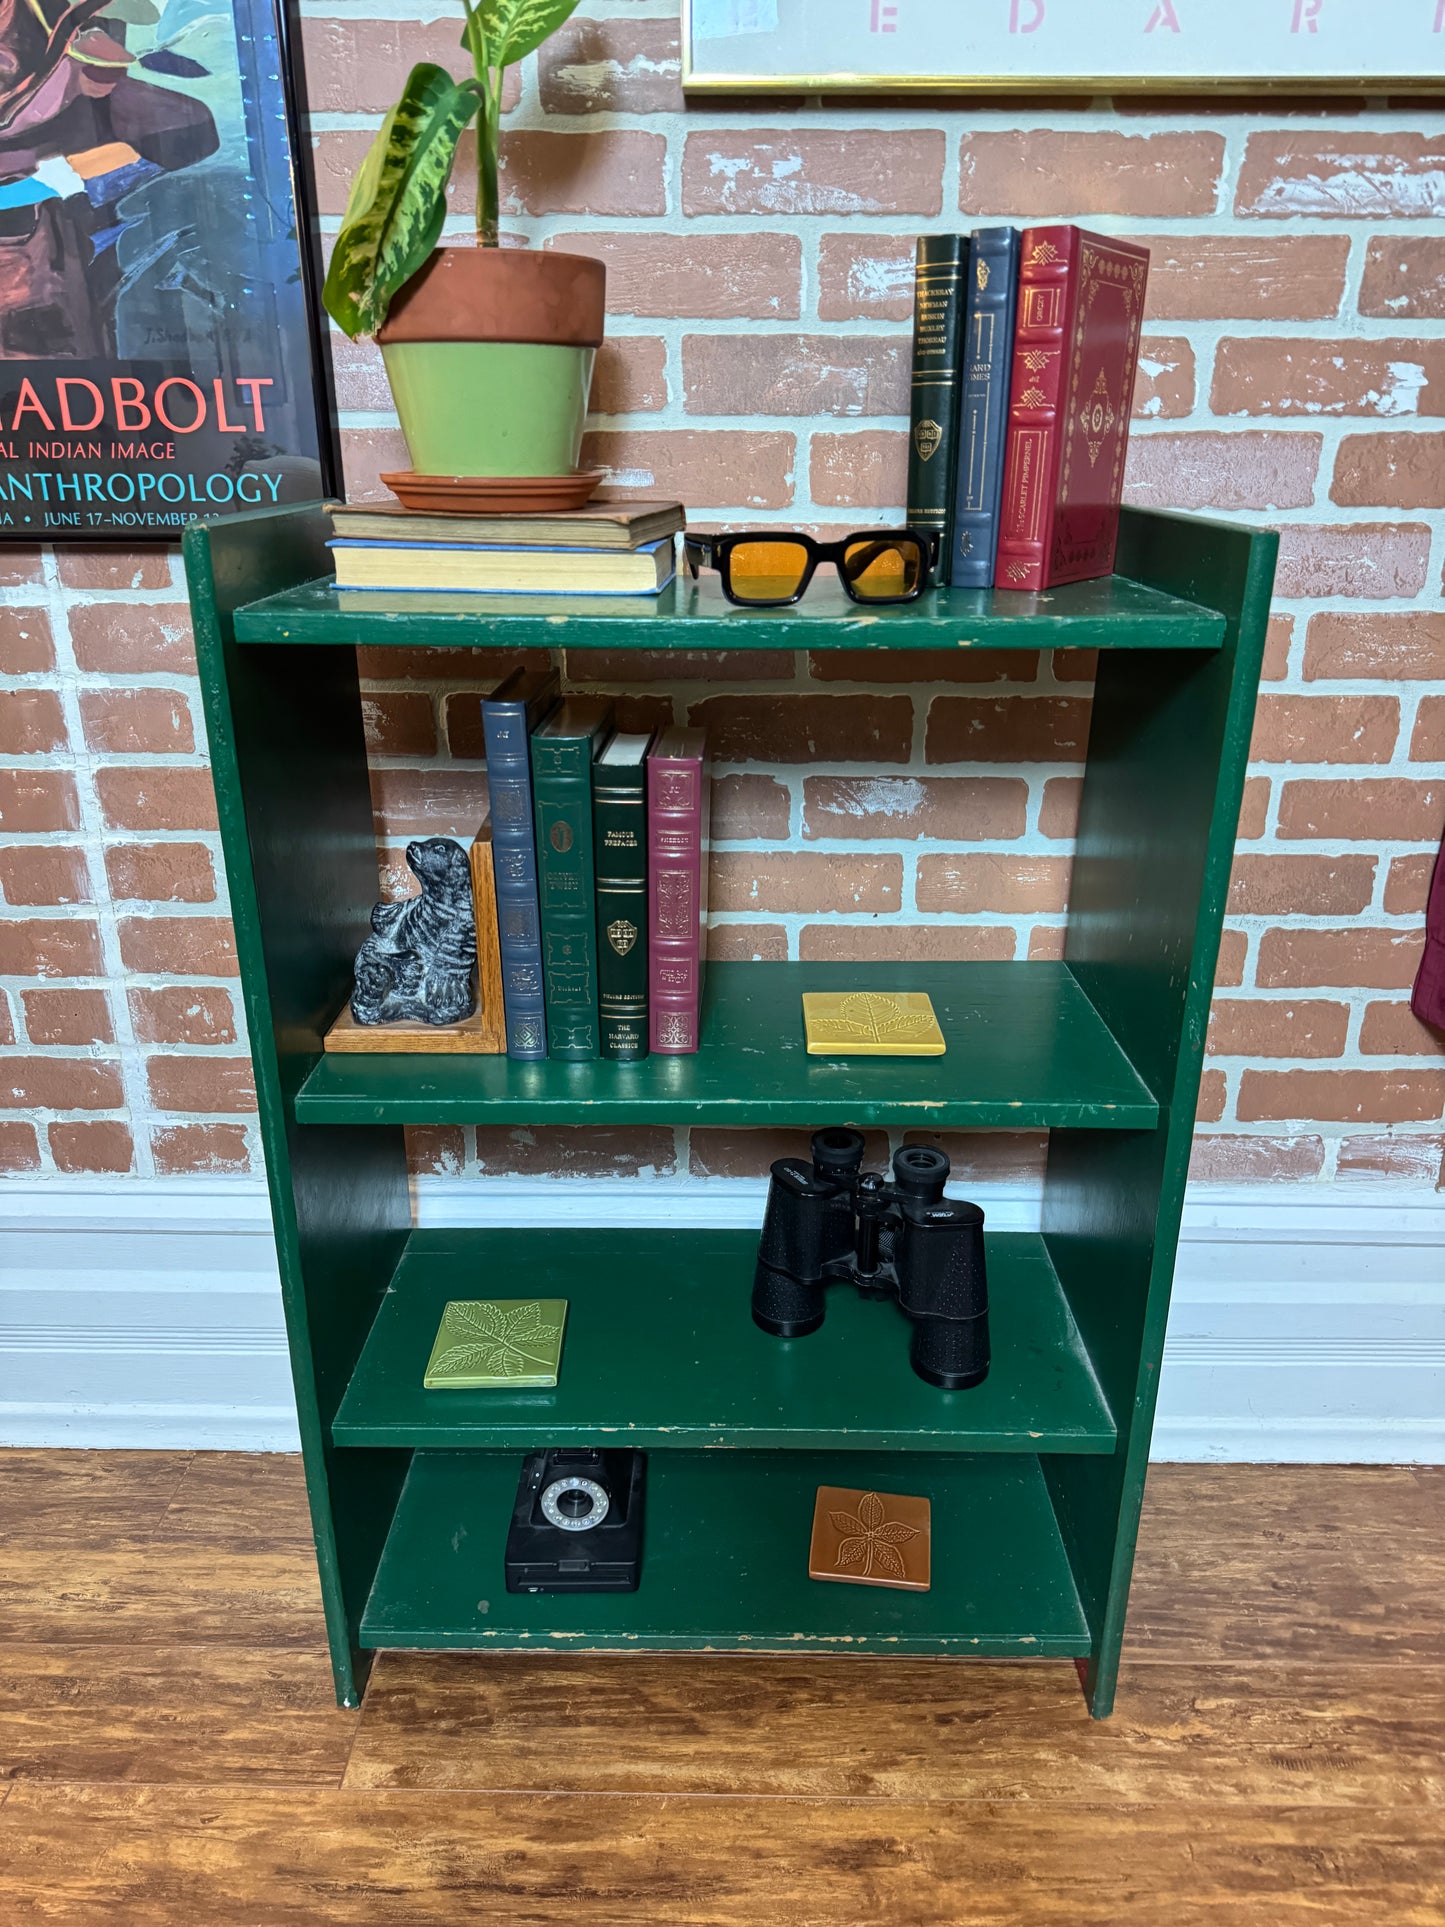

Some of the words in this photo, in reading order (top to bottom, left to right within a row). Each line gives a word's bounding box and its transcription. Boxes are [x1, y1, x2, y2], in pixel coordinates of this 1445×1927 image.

[917, 288, 954, 298] THACKERAY
[1036, 294, 1044, 321] ORCZY
[970, 363, 991, 373] ARD
[970, 373, 991, 381] IMES
[0, 378, 274, 433] ADBOLT
[29, 442, 101, 459] INDIAN
[111, 442, 175, 459] IMAGE
[1022, 438, 1033, 483] PIMPERNEL
[1018, 483, 1028, 519] SCARLET
[44, 512, 81, 527] JUNE
